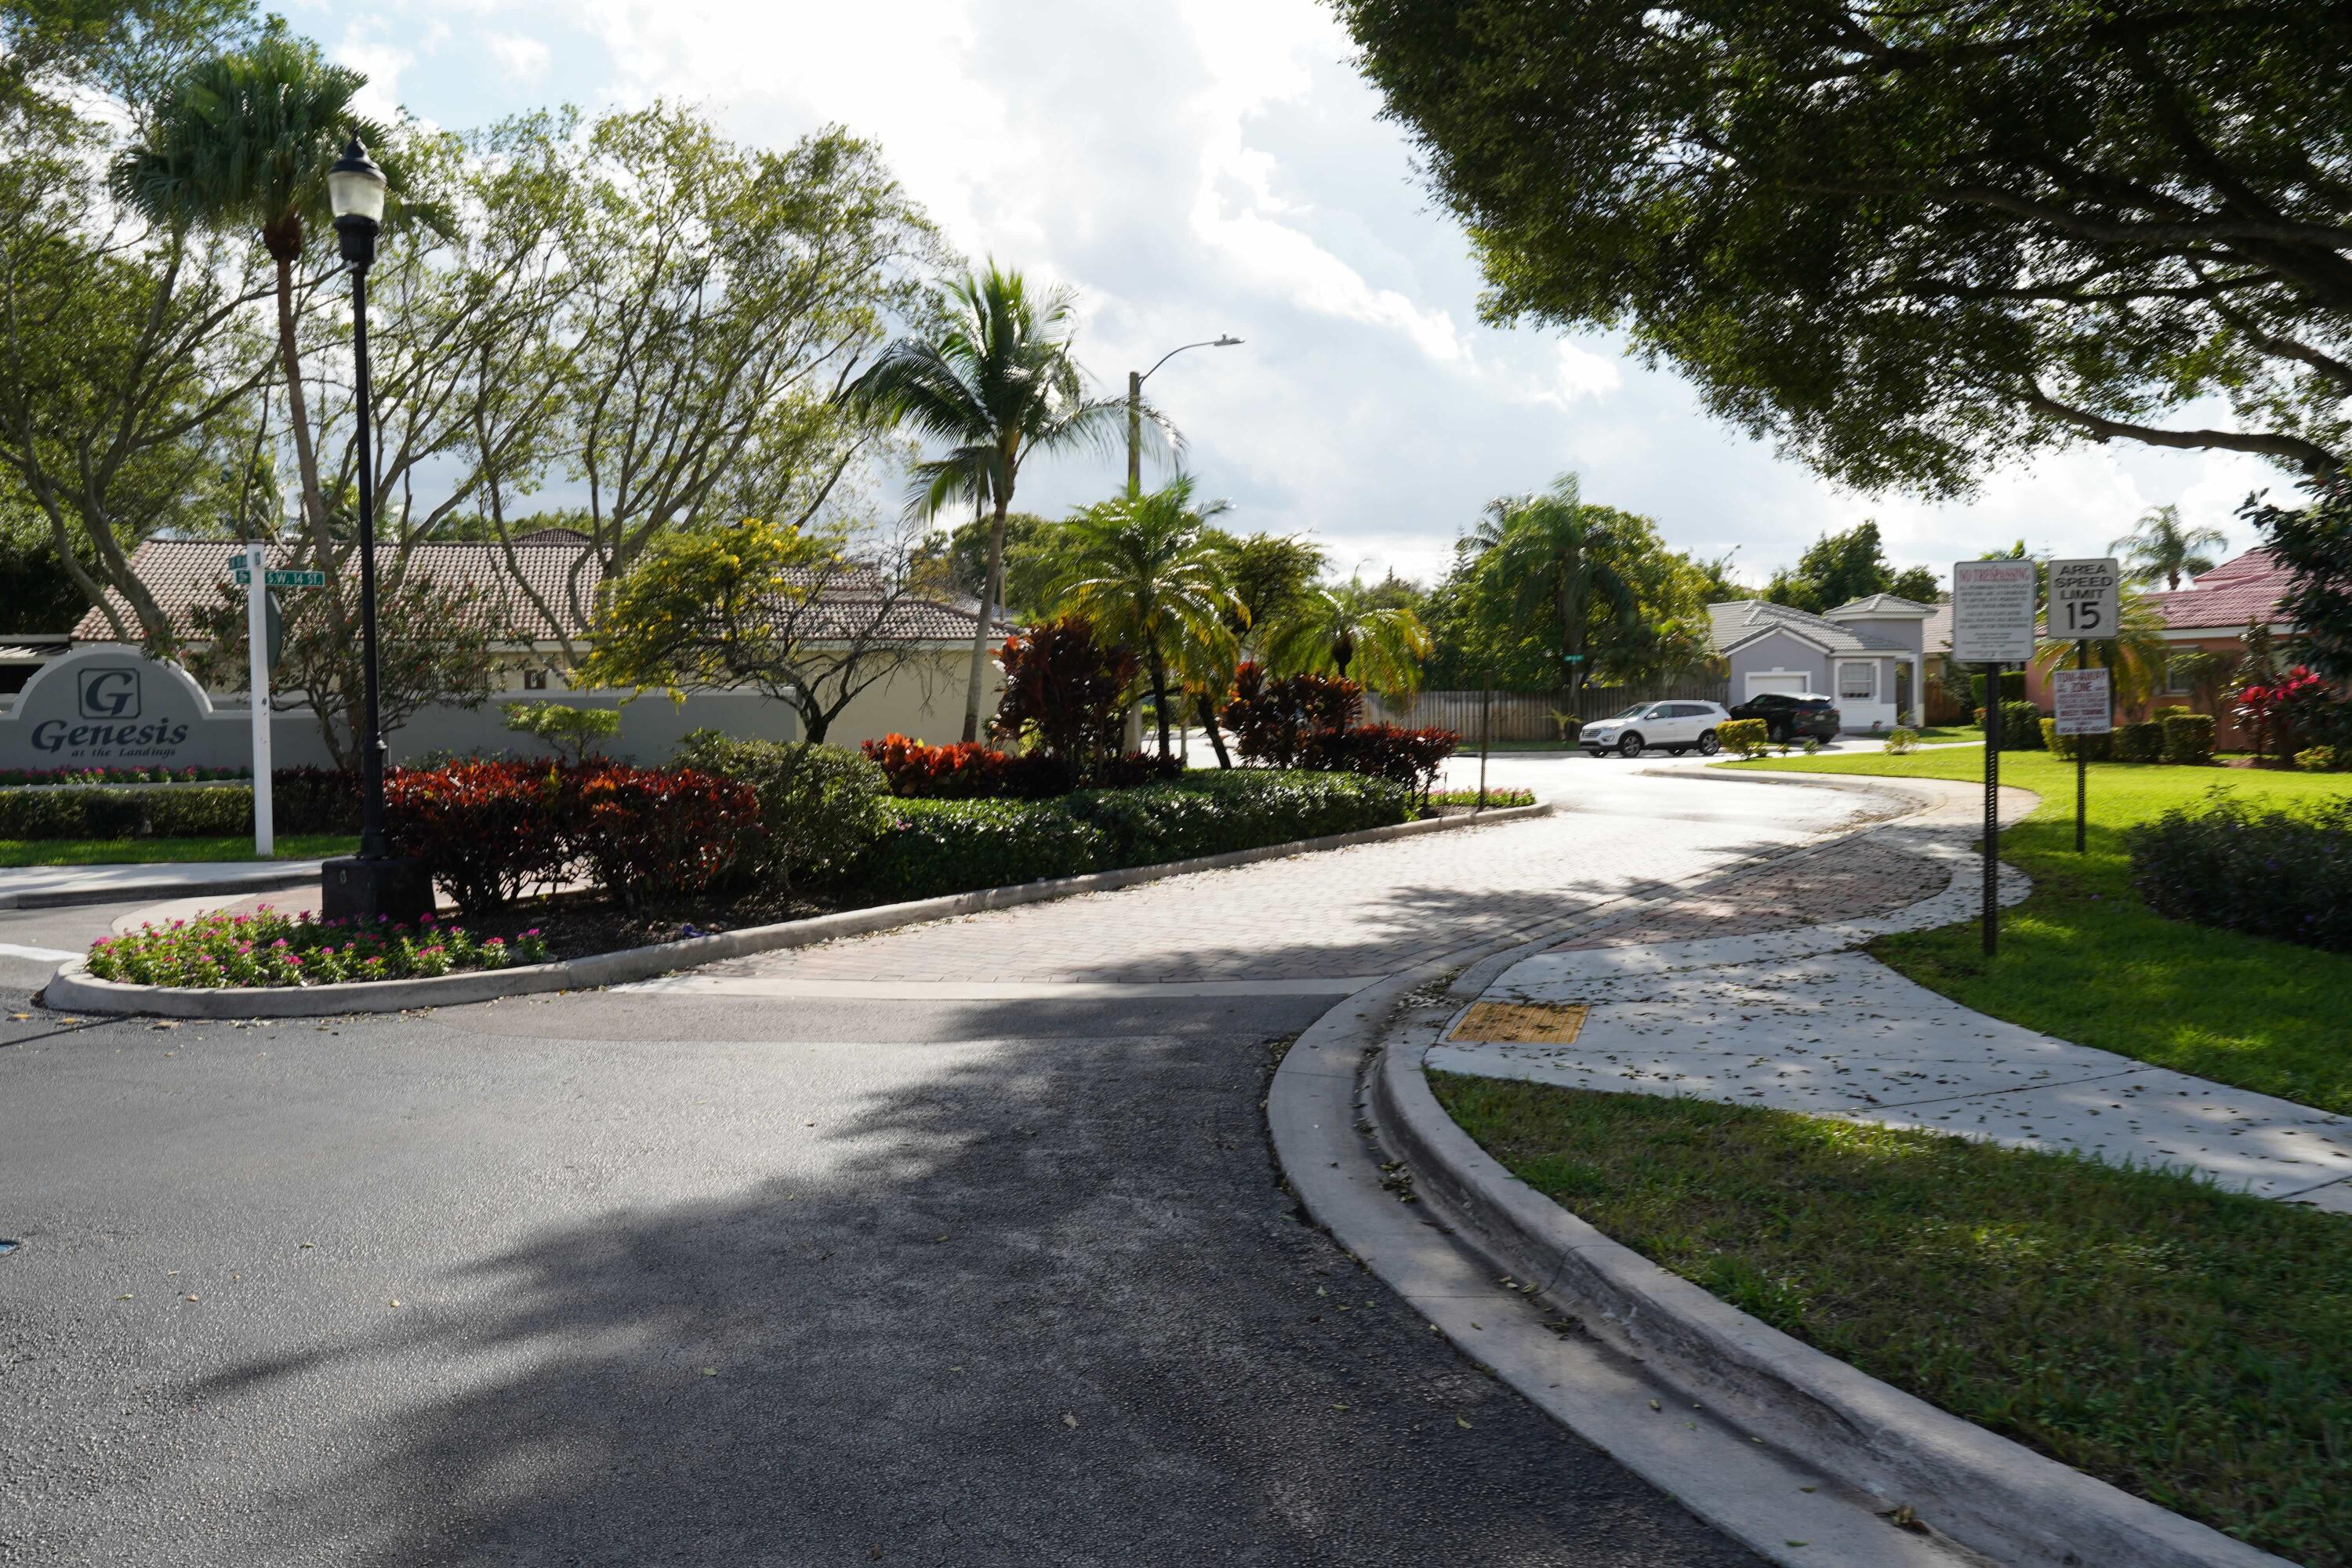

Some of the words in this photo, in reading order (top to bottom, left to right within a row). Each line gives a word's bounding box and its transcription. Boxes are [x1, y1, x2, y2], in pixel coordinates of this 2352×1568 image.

[2059, 564, 2108, 575] AREA
[293, 572, 303, 584] 14
[2054, 576, 2114, 589] SPEED
[2060, 589, 2107, 601] LIMIT
[2066, 601, 2101, 630] 15
[85, 671, 134, 717] G
[31, 717, 189, 753] Genesis
[71, 748, 85, 757] at
[93, 747, 112, 757] the
[118, 746, 176, 759] Landings
